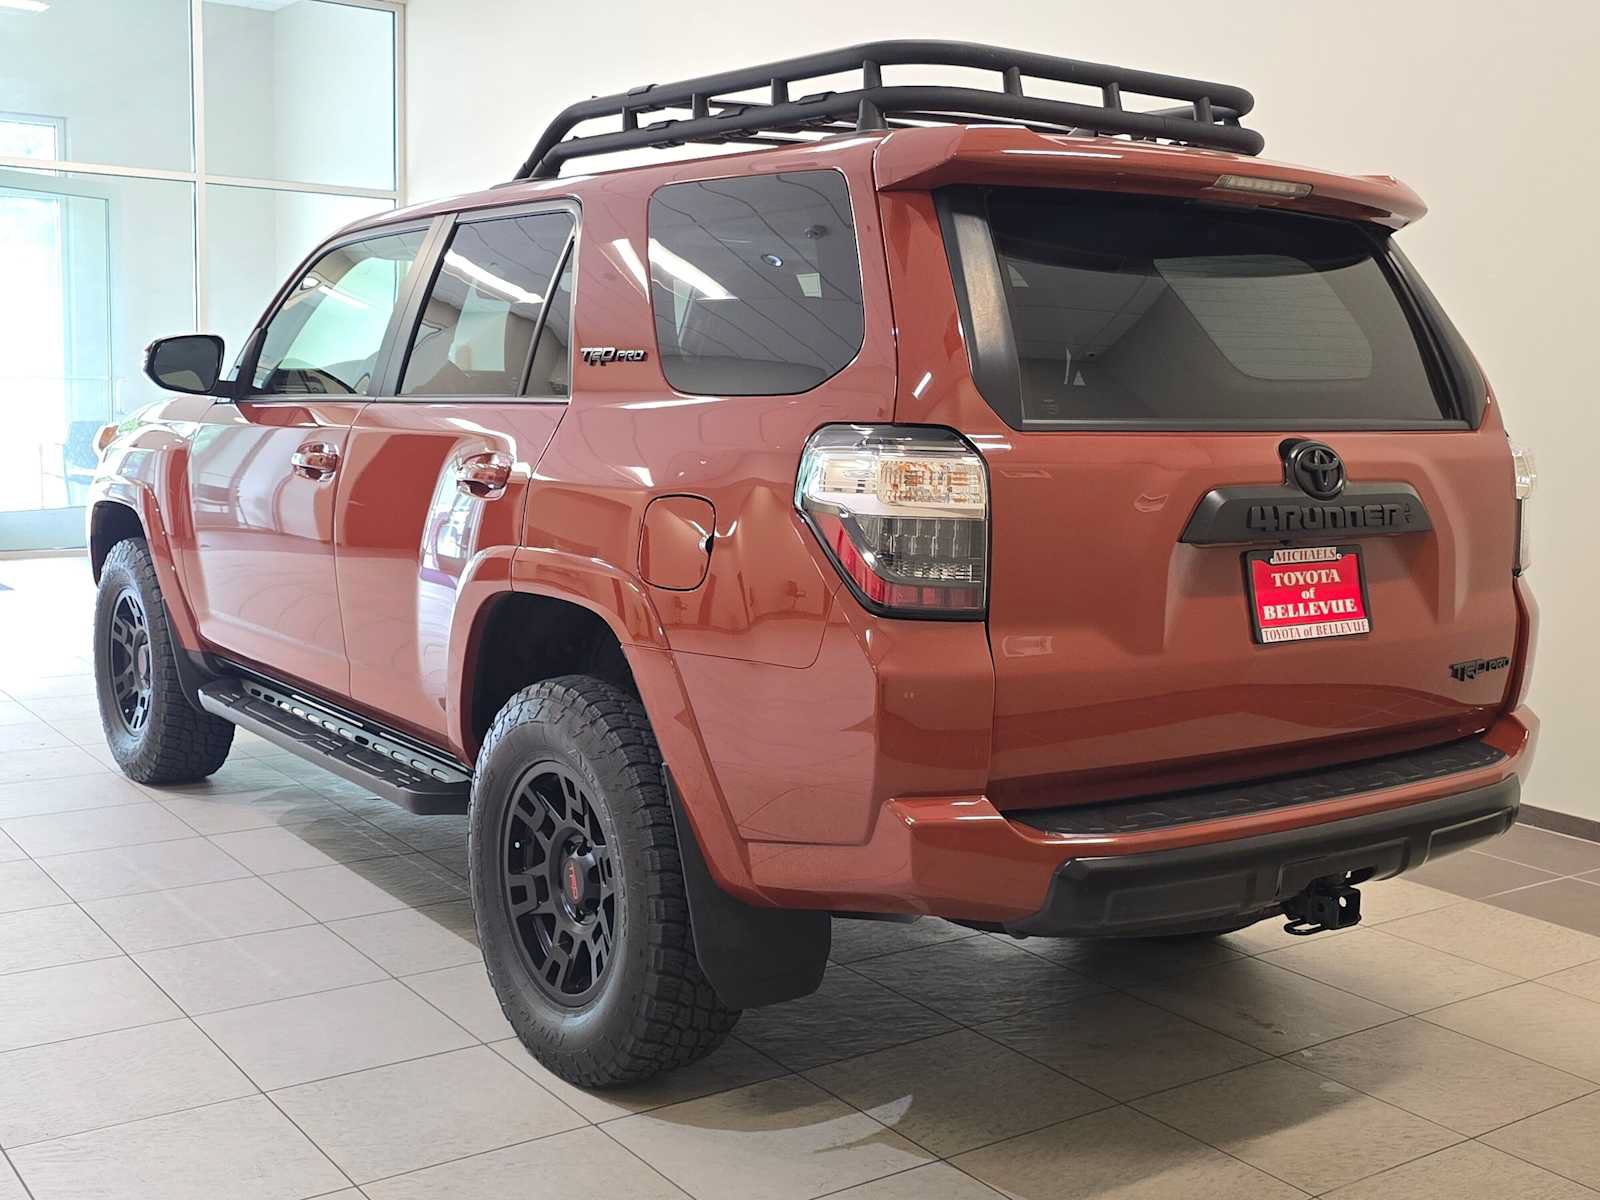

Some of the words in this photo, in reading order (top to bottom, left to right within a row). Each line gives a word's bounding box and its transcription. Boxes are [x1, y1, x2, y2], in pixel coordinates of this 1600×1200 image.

[616, 350, 647, 362] PRO
[1275, 548, 1336, 562] MICHAELS
[1271, 569, 1341, 587] TOYOTA
[1301, 587, 1316, 600] of
[1262, 598, 1358, 620] BELLEVUE
[1264, 626, 1301, 642] TOYOTA
[1303, 625, 1314, 638] of
[1316, 620, 1369, 636] BELLEVUE
